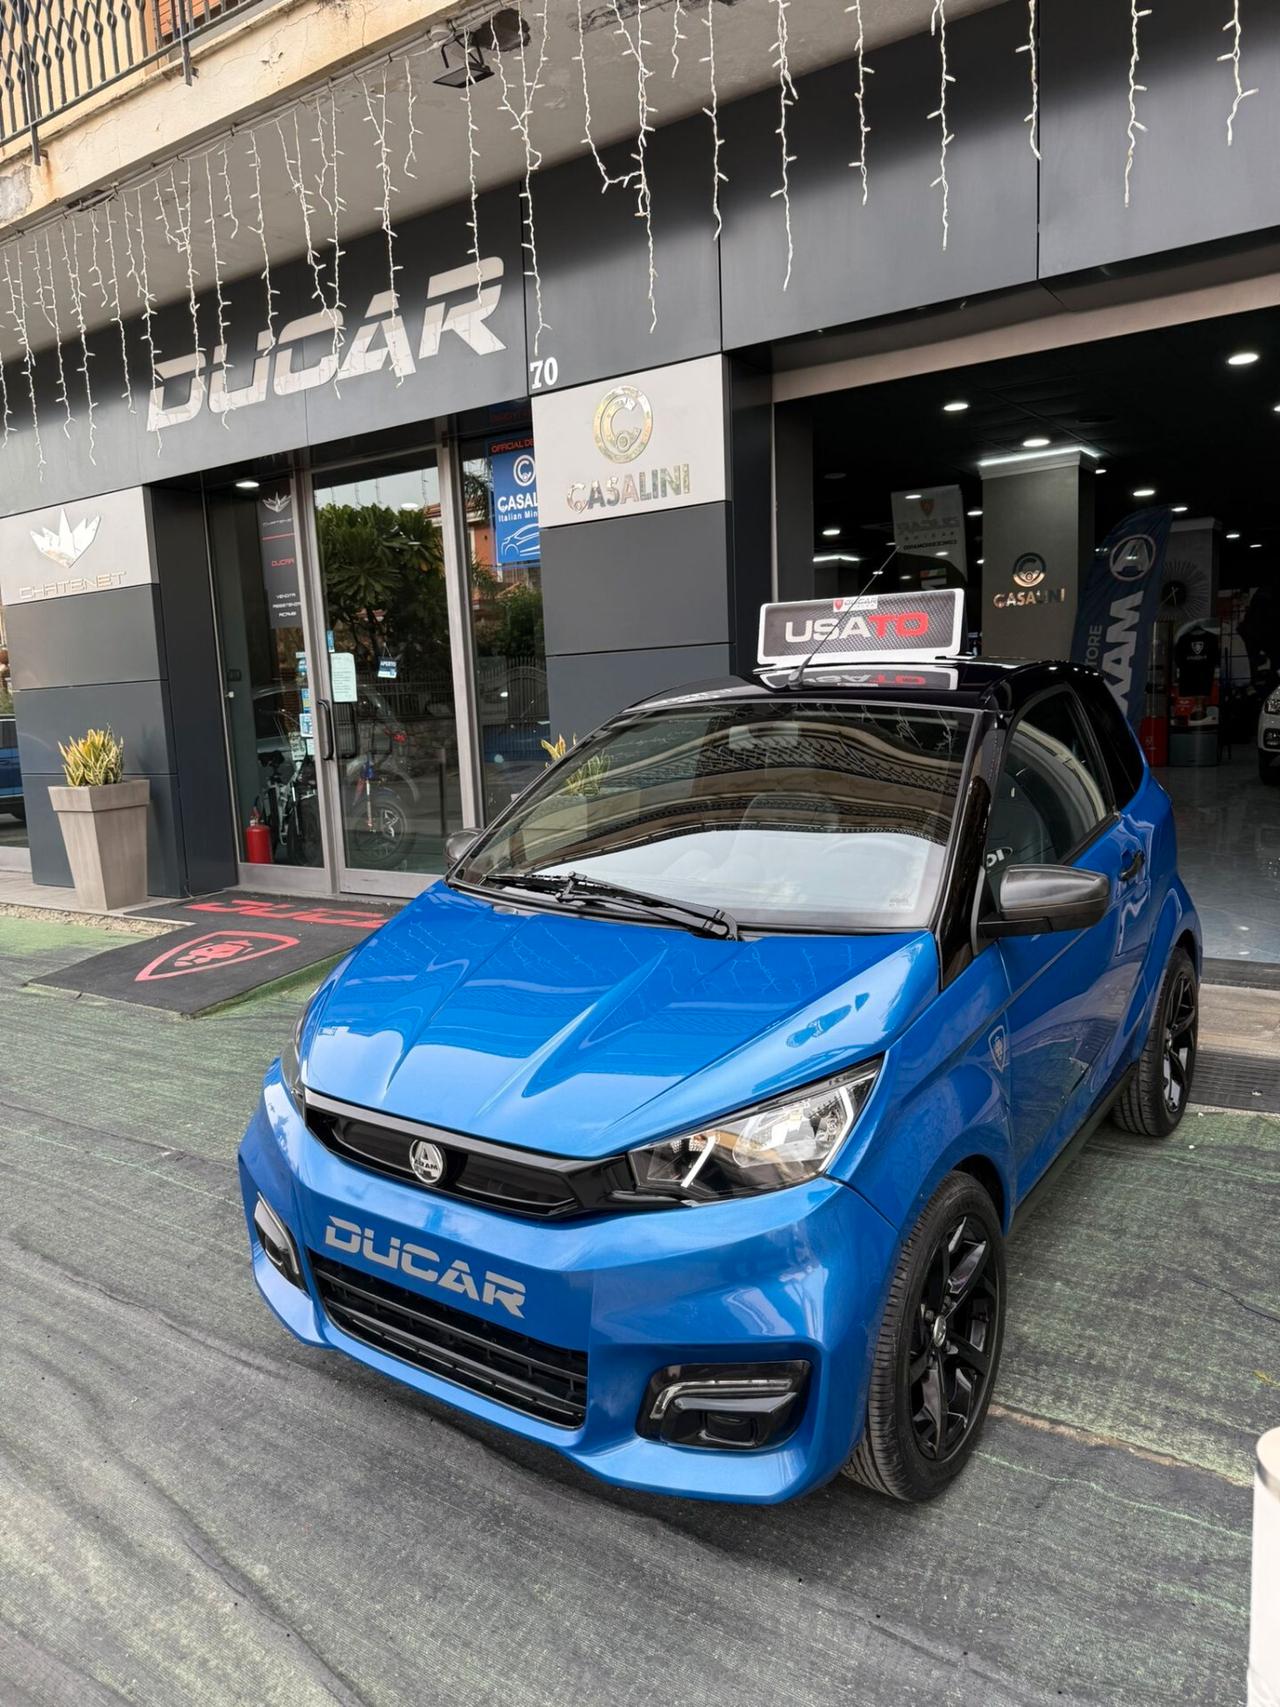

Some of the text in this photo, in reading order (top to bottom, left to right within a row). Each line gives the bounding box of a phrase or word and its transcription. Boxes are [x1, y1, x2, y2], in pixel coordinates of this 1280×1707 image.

[147, 256, 507, 432] DUCAR
[529, 356, 559, 390] 70
[566, 463, 691, 515] CASALINI
[498, 512, 523, 523] Italian
[19, 570, 127, 601] CHATENET
[992, 587, 1065, 608] CASALINI
[785, 611, 929, 643] USATO
[325, 1215, 526, 1319] DUCAR
